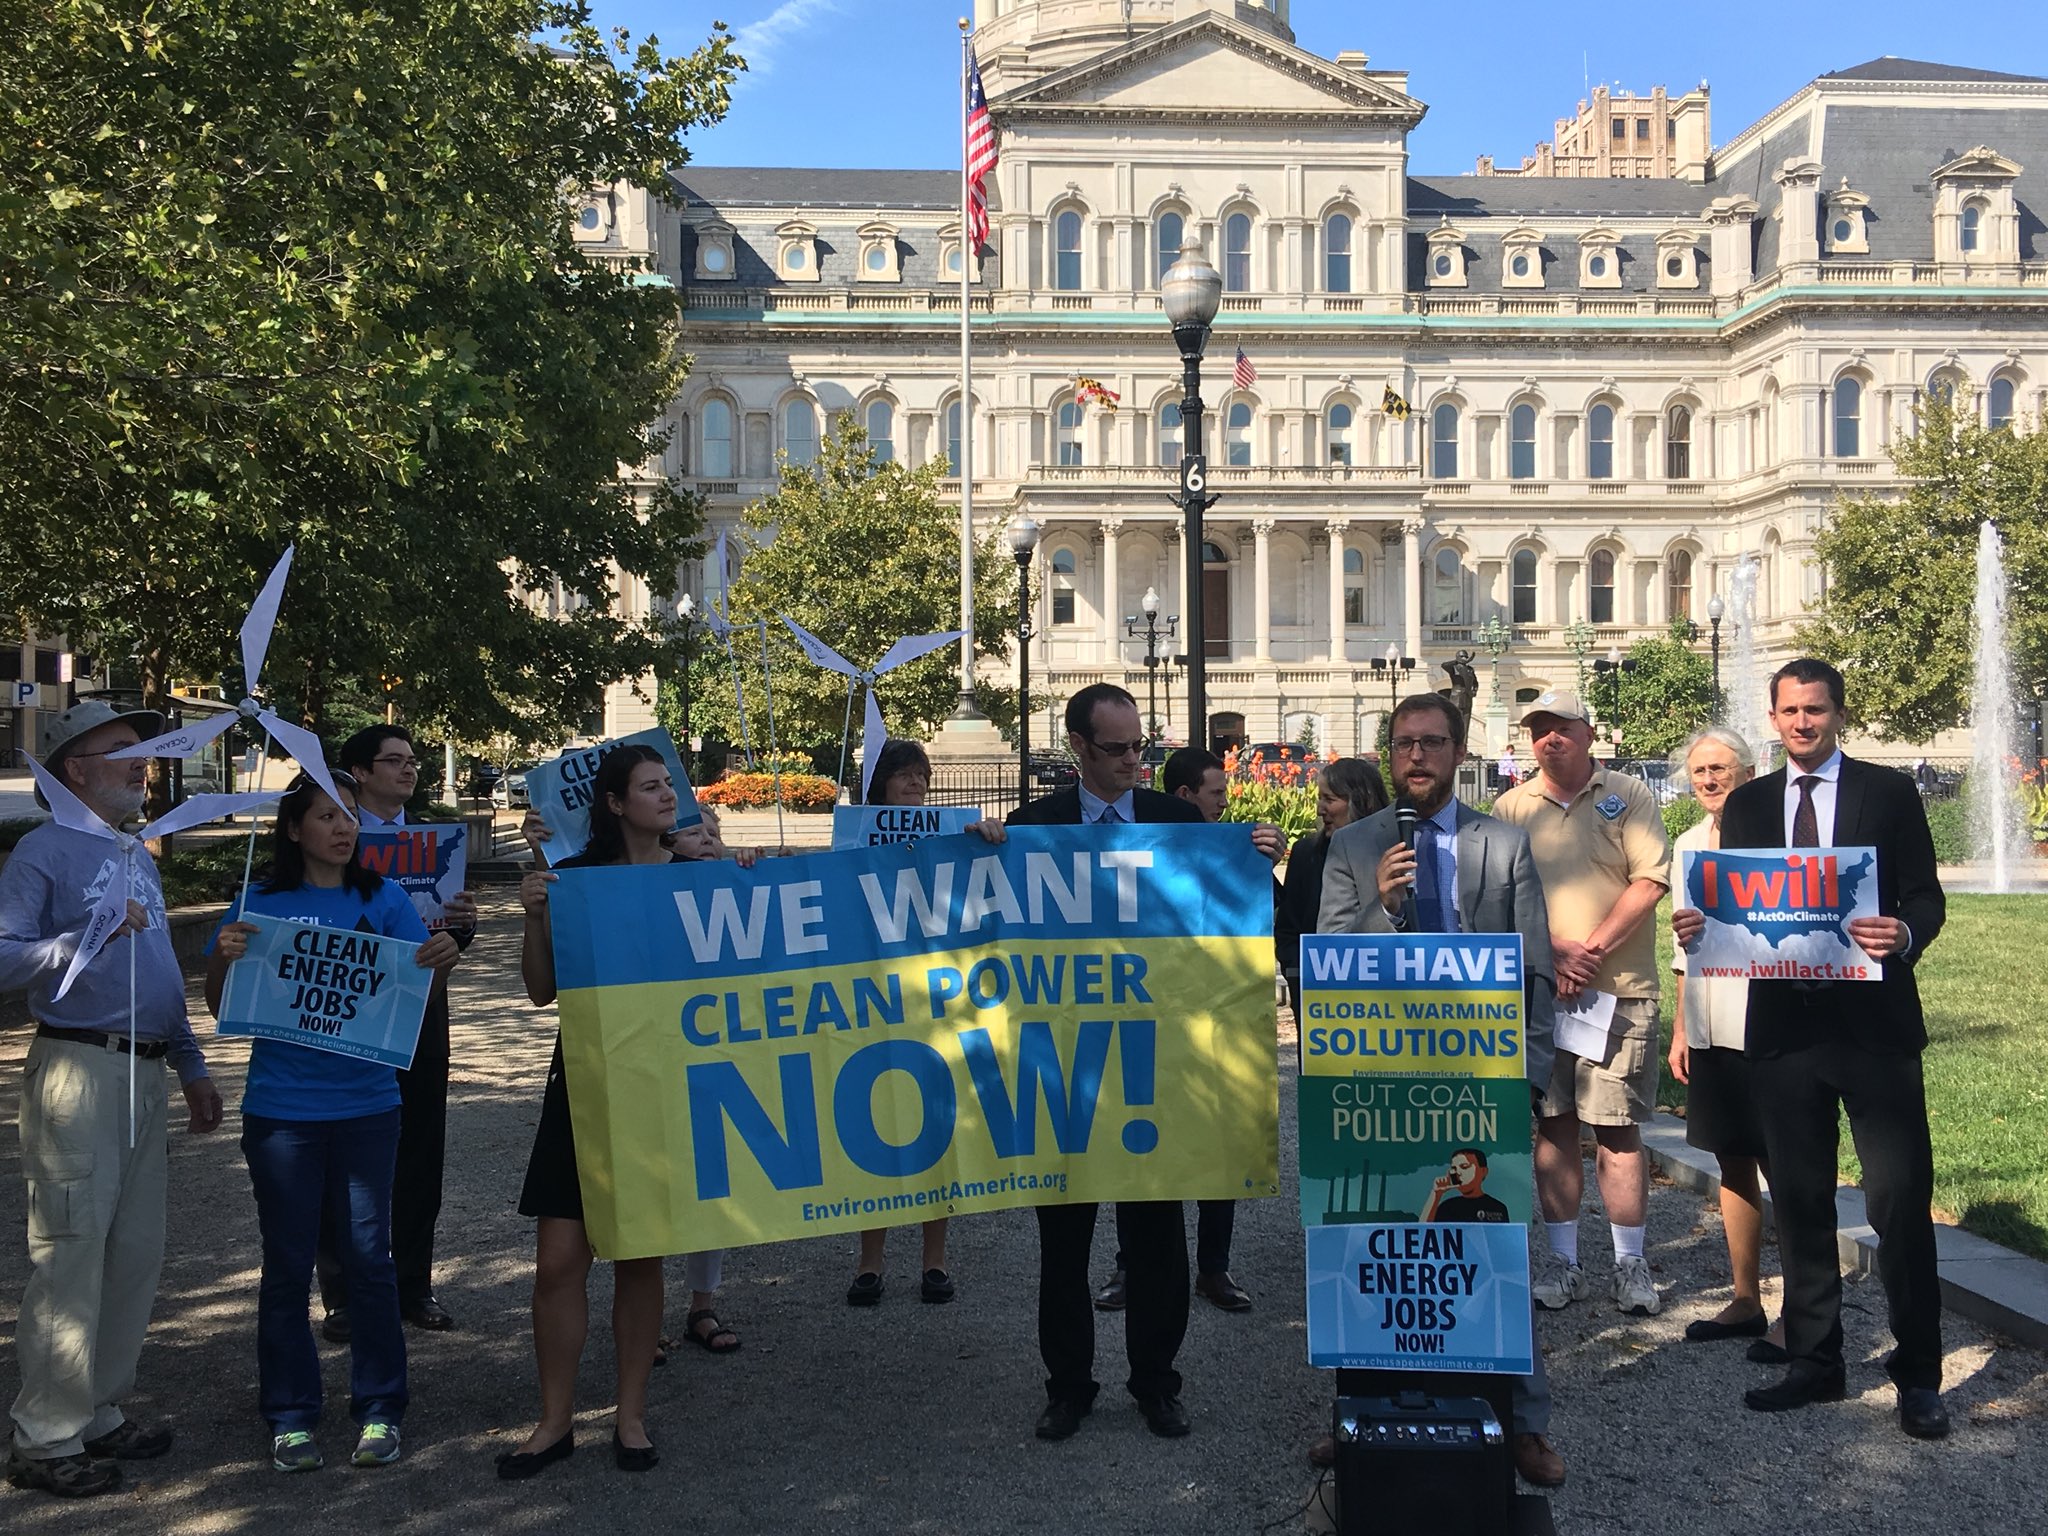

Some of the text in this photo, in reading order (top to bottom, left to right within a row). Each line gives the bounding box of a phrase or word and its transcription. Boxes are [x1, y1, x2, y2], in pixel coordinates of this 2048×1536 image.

[1186, 463, 1204, 492] 6
[1021, 624, 1030, 639] 5
[18, 683, 35, 702] P
[154, 736, 188, 752] OCEANA
[560, 741, 625, 784] CLE
[876, 810, 940, 832] CLEAN
[1703, 854, 1839, 908] I will
[673, 850, 1154, 963] WE WANT
[1747, 911, 1840, 922] #ActOnClimate
[86, 914, 106, 951] OCEANA
[293, 929, 380, 968] CLEAN
[278, 953, 386, 997] ENERGY
[1308, 947, 1517, 982] WE HAVE
[1701, 960, 1868, 979] www.iwillact.us
[290, 985, 359, 1021] JOBS
[680, 953, 1153, 1047] CLEAN POWER
[1308, 1002, 1518, 1020] GLOBAL WARMING
[298, 1013, 343, 1037] NOW!
[250, 1026, 379, 1060] www.chesapeakeclimate.org
[1308, 1028, 1519, 1058] SOLUTIONS
[1352, 1069, 1474, 1079] EnvironmentAmerica.org
[686, 1019, 1160, 1201] NOW!
[1332, 1083, 1498, 1108] CUT COAL
[1332, 1108, 1498, 1143] POLLUTION
[801, 1169, 1068, 1222] EnvironmentAmerica.org
[1368, 1228, 1464, 1260] CLEAN
[1358, 1263, 1478, 1296] ENERGY
[1381, 1297, 1457, 1331] JOBS
[1395, 1333, 1445, 1353] NOW!
[1342, 1356, 1495, 1371] www.chesapeakeclimate.org
